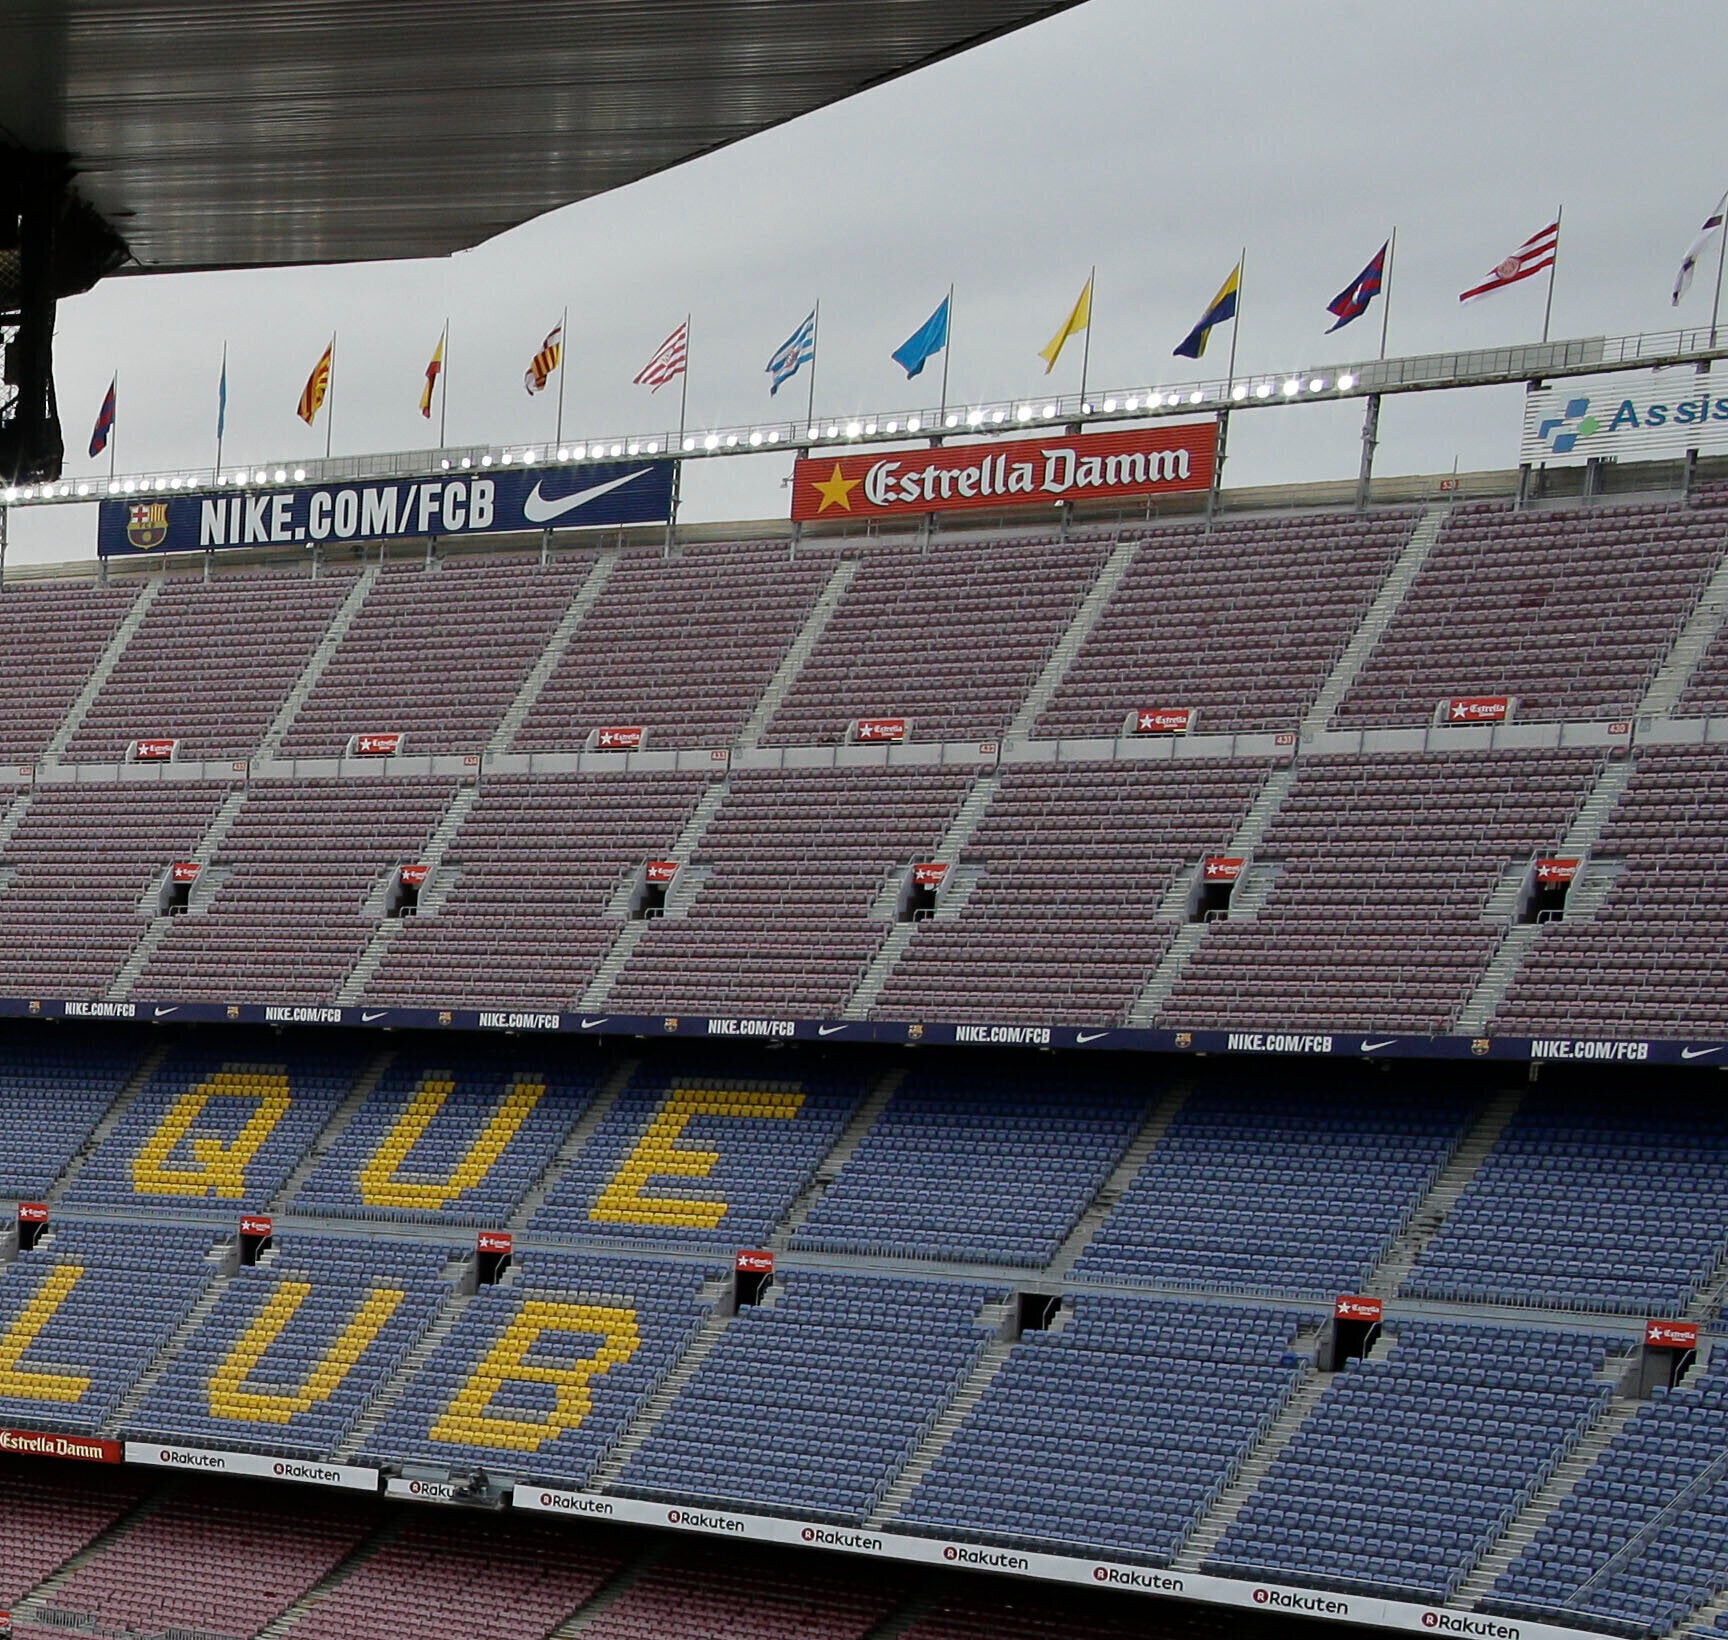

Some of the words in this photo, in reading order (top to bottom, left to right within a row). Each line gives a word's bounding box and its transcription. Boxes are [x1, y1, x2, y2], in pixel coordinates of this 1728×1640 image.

[865, 455, 1033, 507] Estrella
[1040, 448, 1190, 492] Damm
[199, 480, 495, 547] NIKE.COM/FCB
[65, 1002, 135, 1016] NIKE.COM/FCB
[266, 1007, 341, 1022] NIKE.COM/FCB
[479, 1013, 559, 1028] NIKE.COM/FCB
[708, 1020, 794, 1036] NIKE.COM/FCB
[956, 1026, 1050, 1043] NIKE.COM/FCB
[1228, 1034, 1332, 1052] NIKE.COM/FCB
[1531, 1041, 1648, 1059] NIKE.COM/FCB
[132, 1064, 807, 1230] QUE
[0, 1428, 55, 1453] Estrella
[56, 1438, 104, 1459] Damm
[173, 1451, 225, 1469] Rakuten
[286, 1464, 340, 1481] Rakuten
[422, 1482, 456, 1497] Raku
[554, 1494, 613, 1514] Rakuten
[682, 1511, 744, 1532] Rakuten
[816, 1528, 882, 1550] Rakuten
[958, 1546, 1028, 1570] Rakuten
[1109, 1568, 1183, 1592] Rakuten
[1270, 1590, 1348, 1615] Rakuten
[1439, 1612, 1519, 1640] Rakuten
